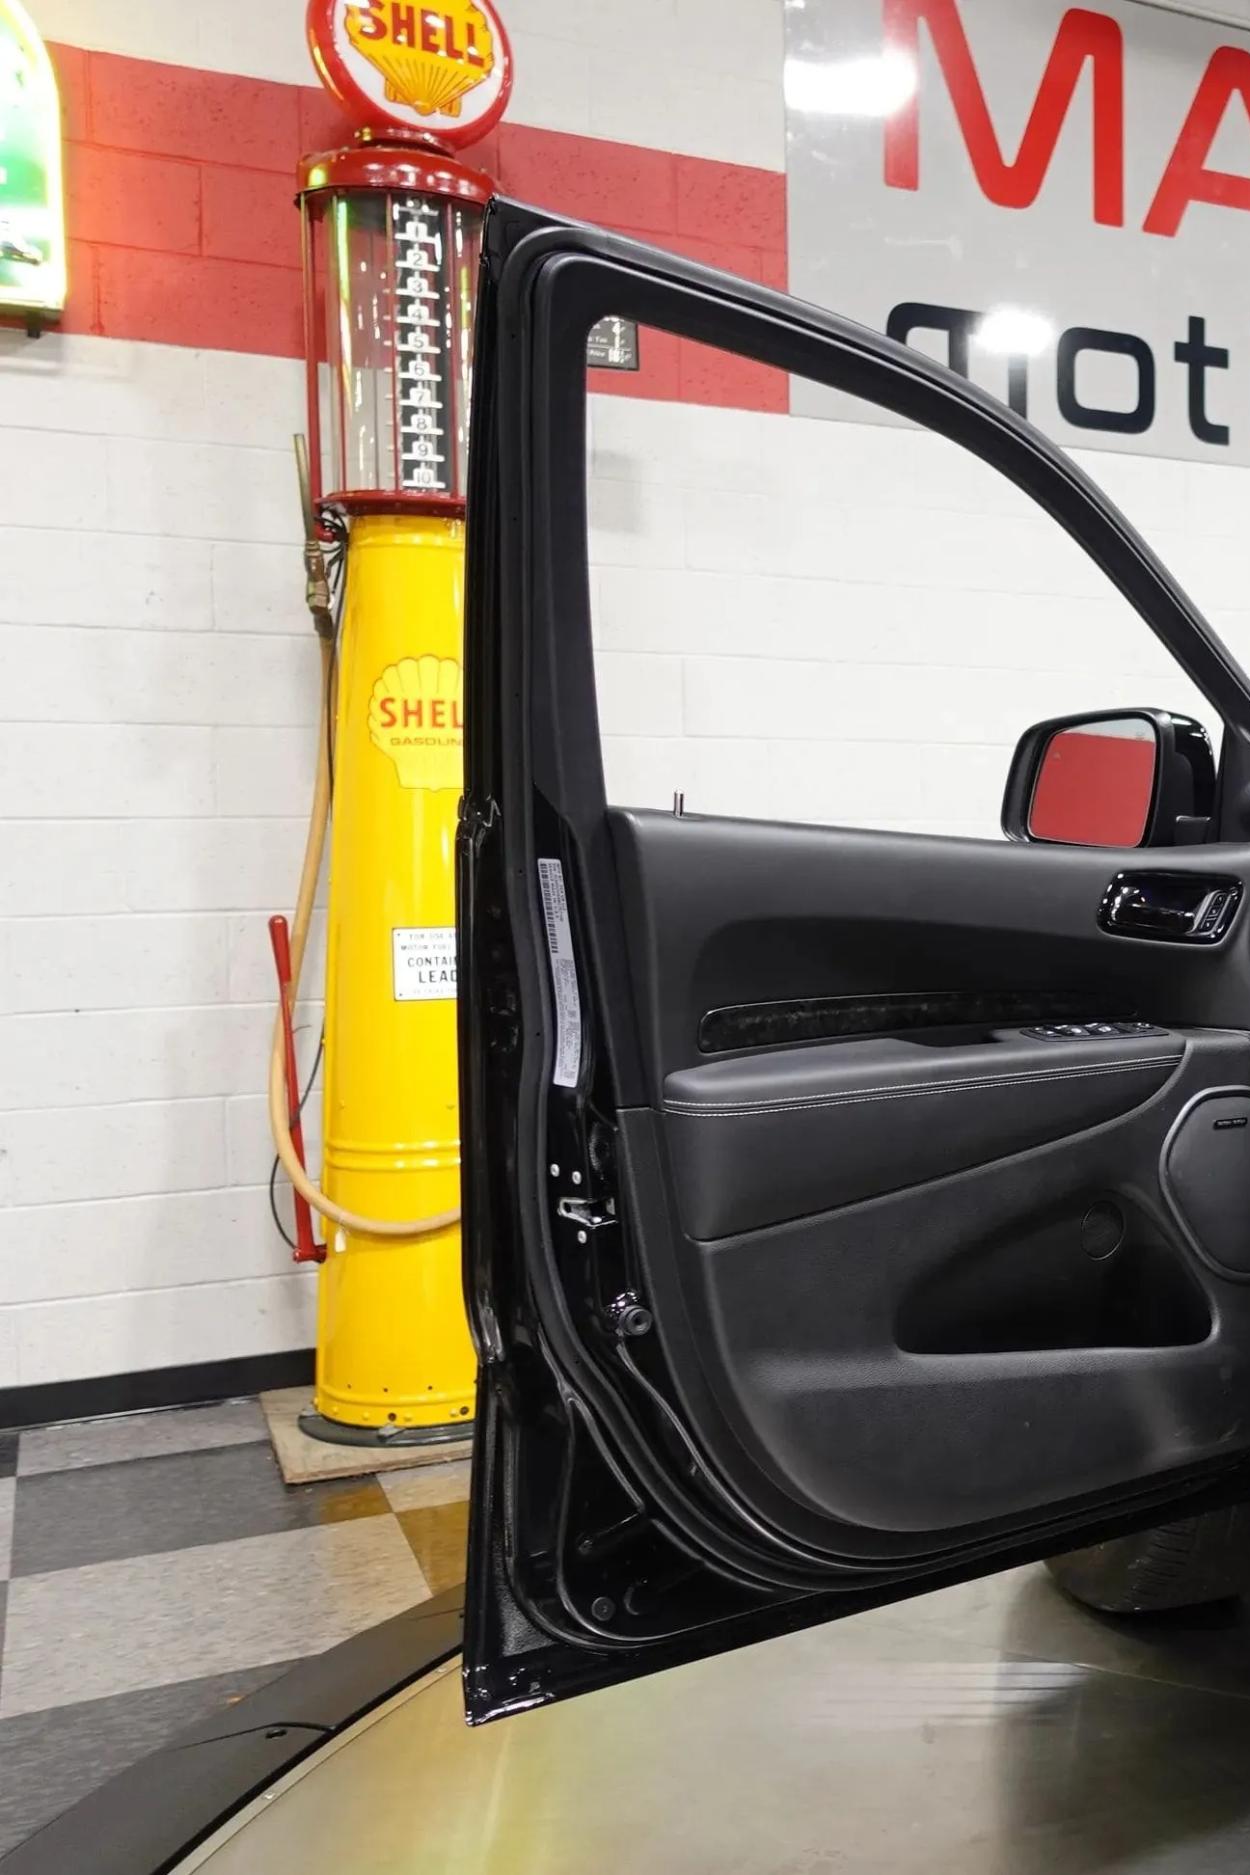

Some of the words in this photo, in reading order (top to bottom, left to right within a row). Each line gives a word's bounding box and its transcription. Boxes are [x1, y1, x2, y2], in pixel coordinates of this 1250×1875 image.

[357, 0, 485, 68] SHELL
[380, 697, 463, 729] SHEL
[390, 737, 463, 746] GASOLIN
